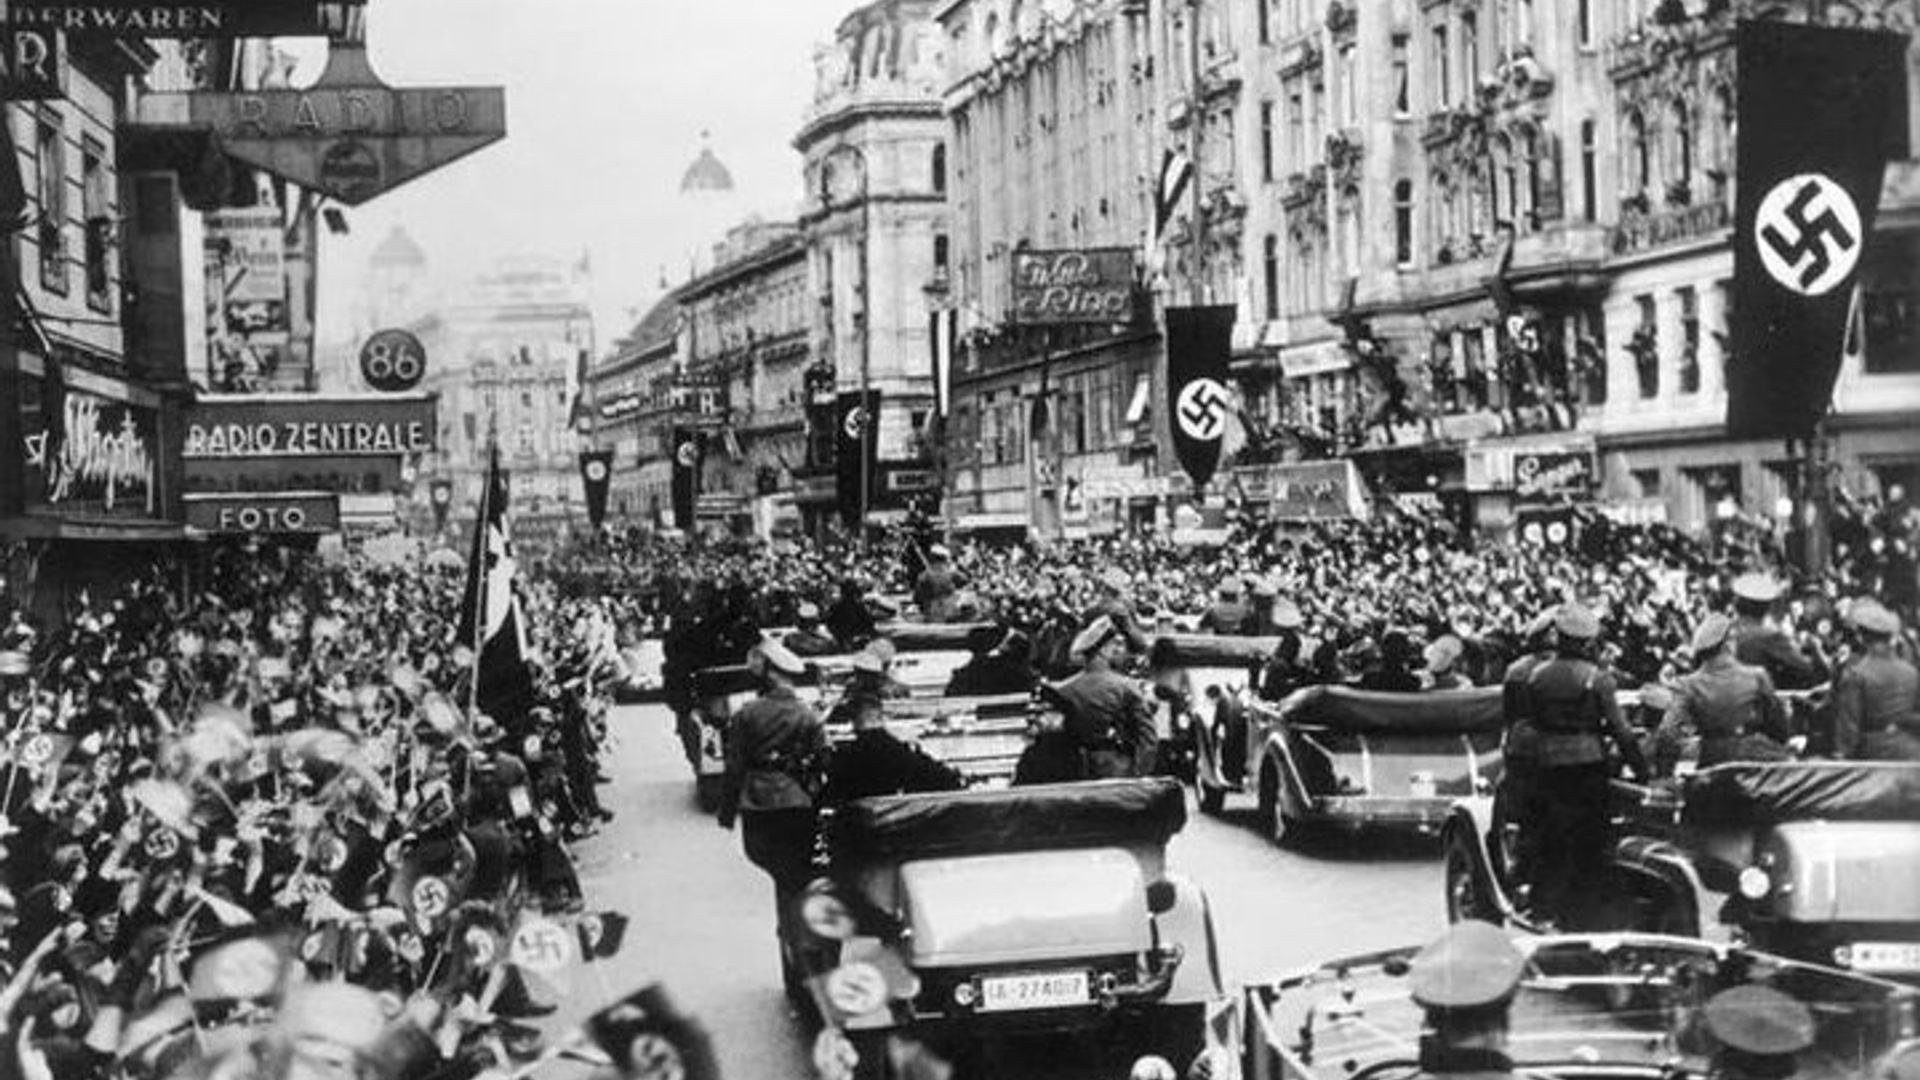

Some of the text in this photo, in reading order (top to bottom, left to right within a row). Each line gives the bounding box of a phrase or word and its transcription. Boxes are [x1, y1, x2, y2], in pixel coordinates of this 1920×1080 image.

[370, 343, 419, 379] 86
[185, 421, 431, 453] RADIO ZENTRALE
[220, 507, 305, 529] FOTO
